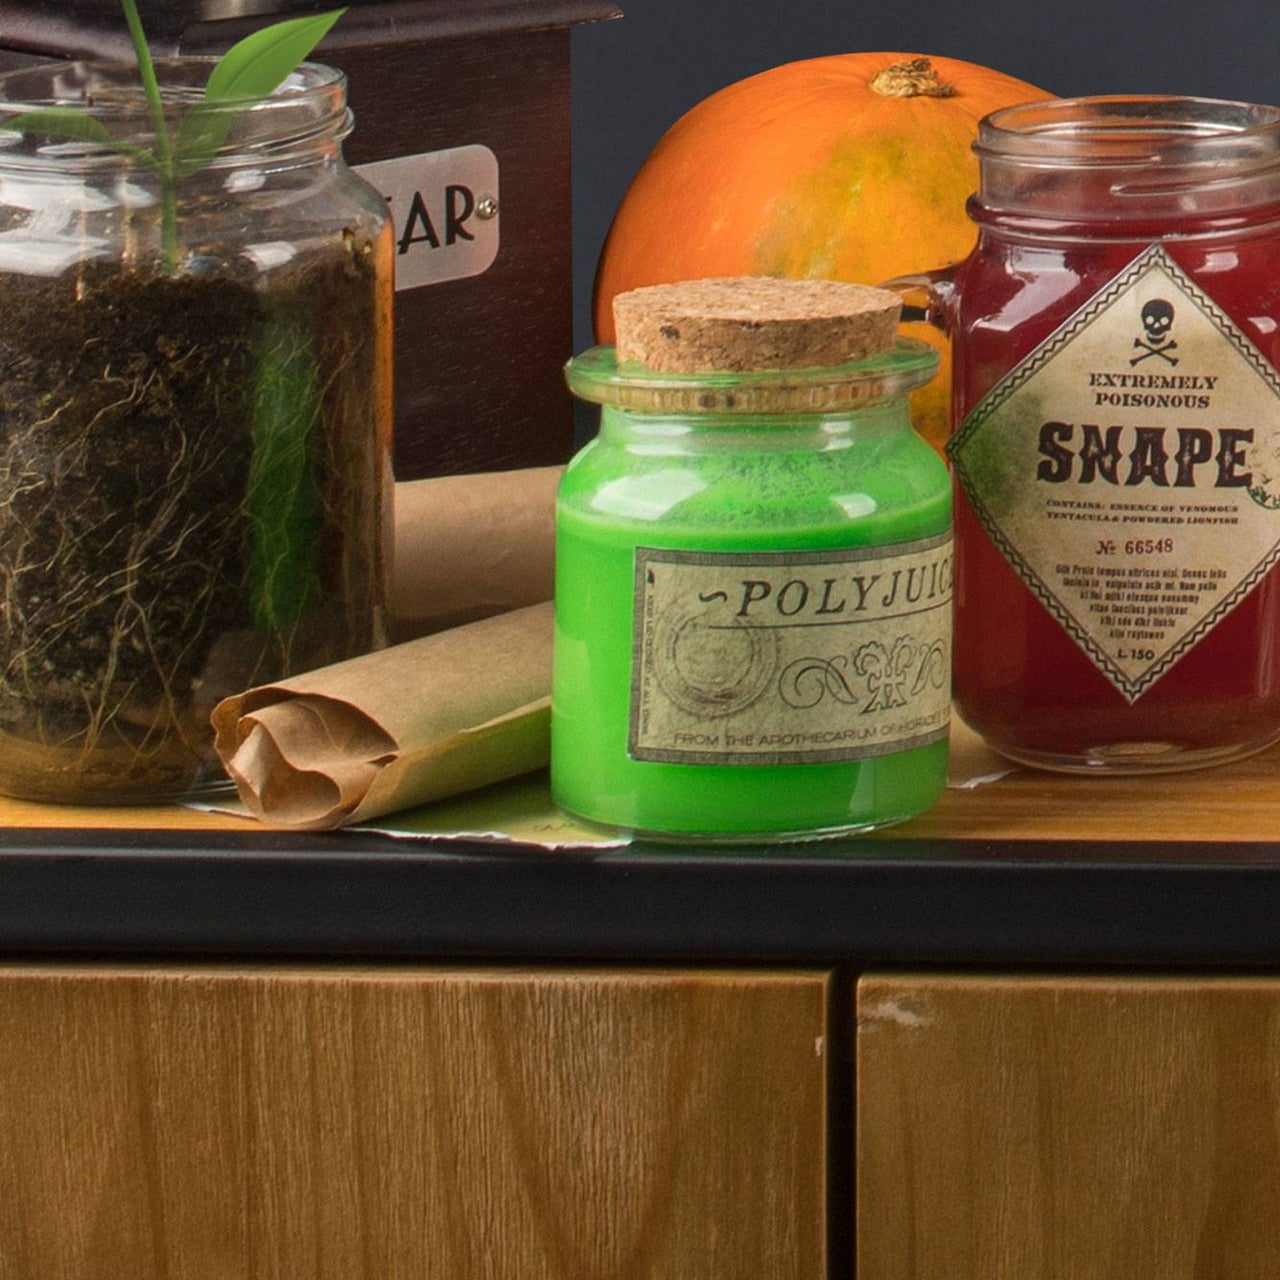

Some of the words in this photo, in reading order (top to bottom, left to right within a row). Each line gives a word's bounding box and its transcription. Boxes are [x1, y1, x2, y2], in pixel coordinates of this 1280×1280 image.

[384, 184, 475, 255] AR
[1089, 373, 1218, 389] EXTREMELY
[1095, 393, 1210, 409] POISONOUS
[1037, 421, 1254, 488] SNAPE
[1122, 516, 1184, 524] POWDERED
[1125, 538, 1173, 555] 66548
[736, 559, 952, 616] POLYJUIC
[1131, 649, 1155, 660] 150
[674, 733, 718, 745] FROM
[726, 734, 753, 746] THE
